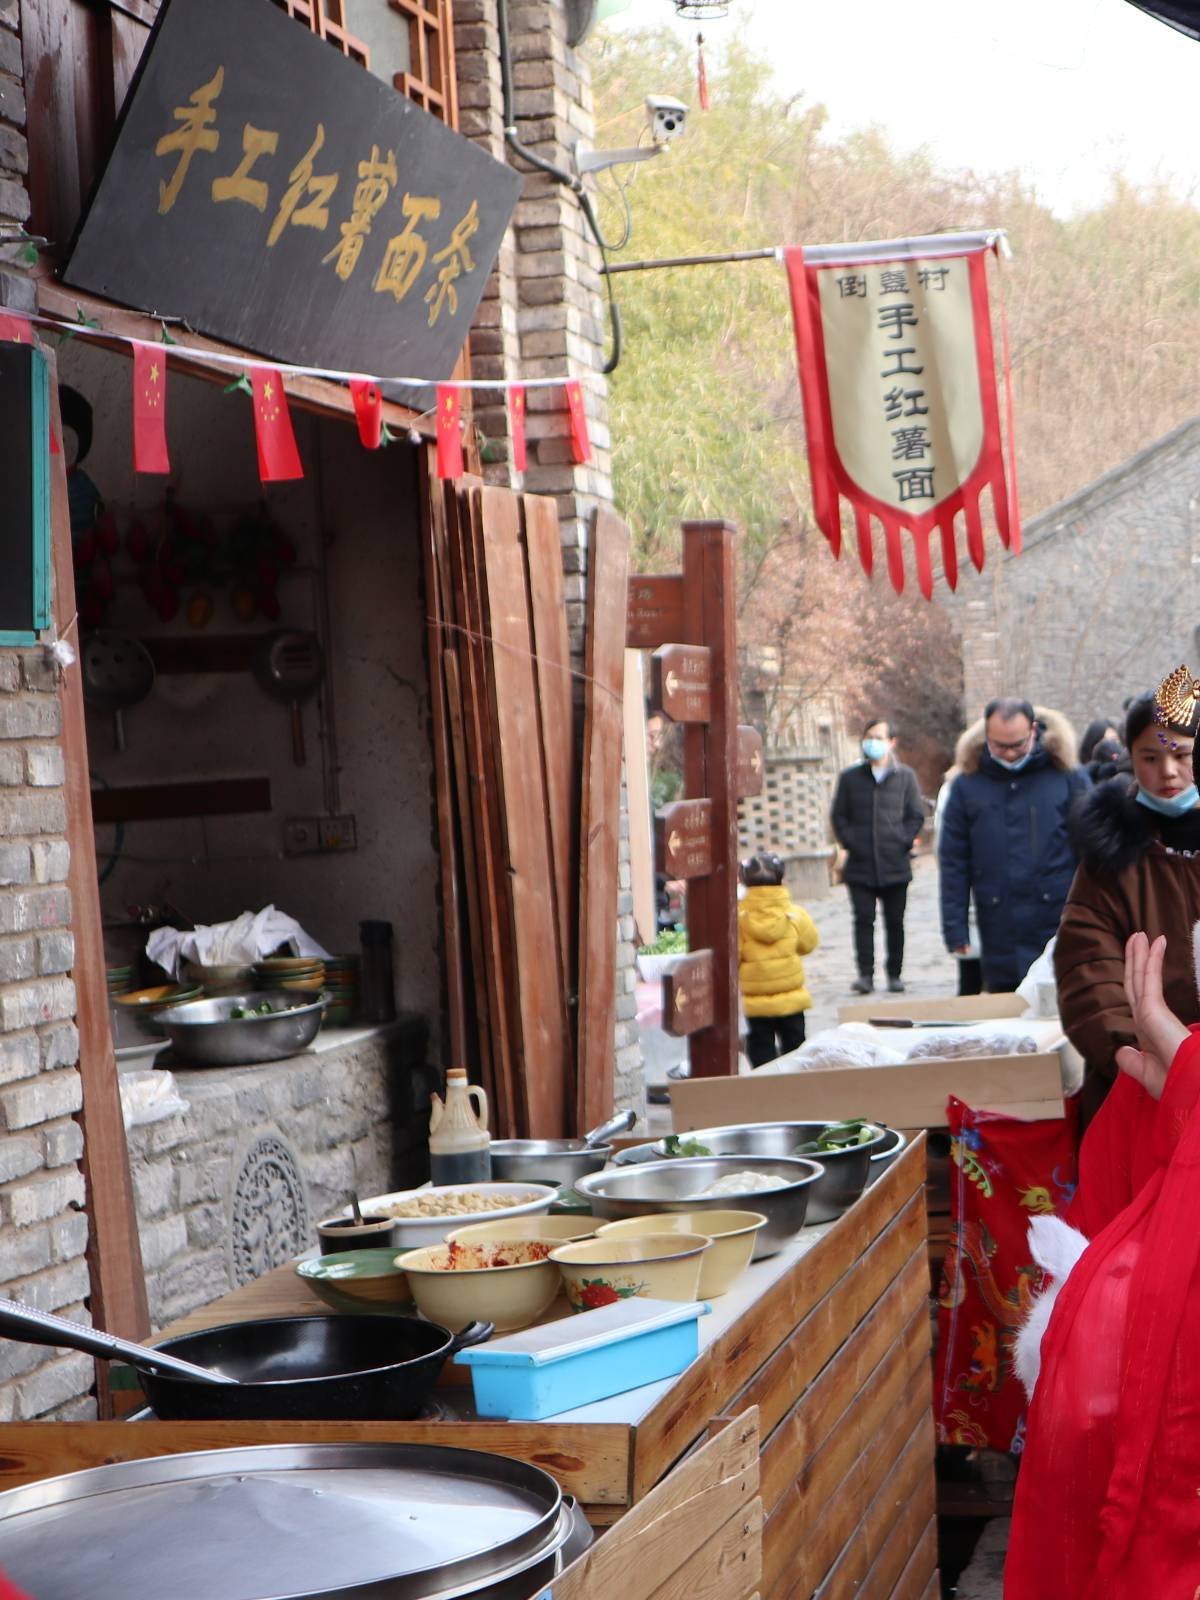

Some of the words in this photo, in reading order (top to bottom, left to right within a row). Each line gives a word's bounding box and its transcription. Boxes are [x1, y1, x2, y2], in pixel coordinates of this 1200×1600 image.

[156, 65, 480, 327] 手工红薯面条
[878, 303, 936, 502] 手工红薯面
